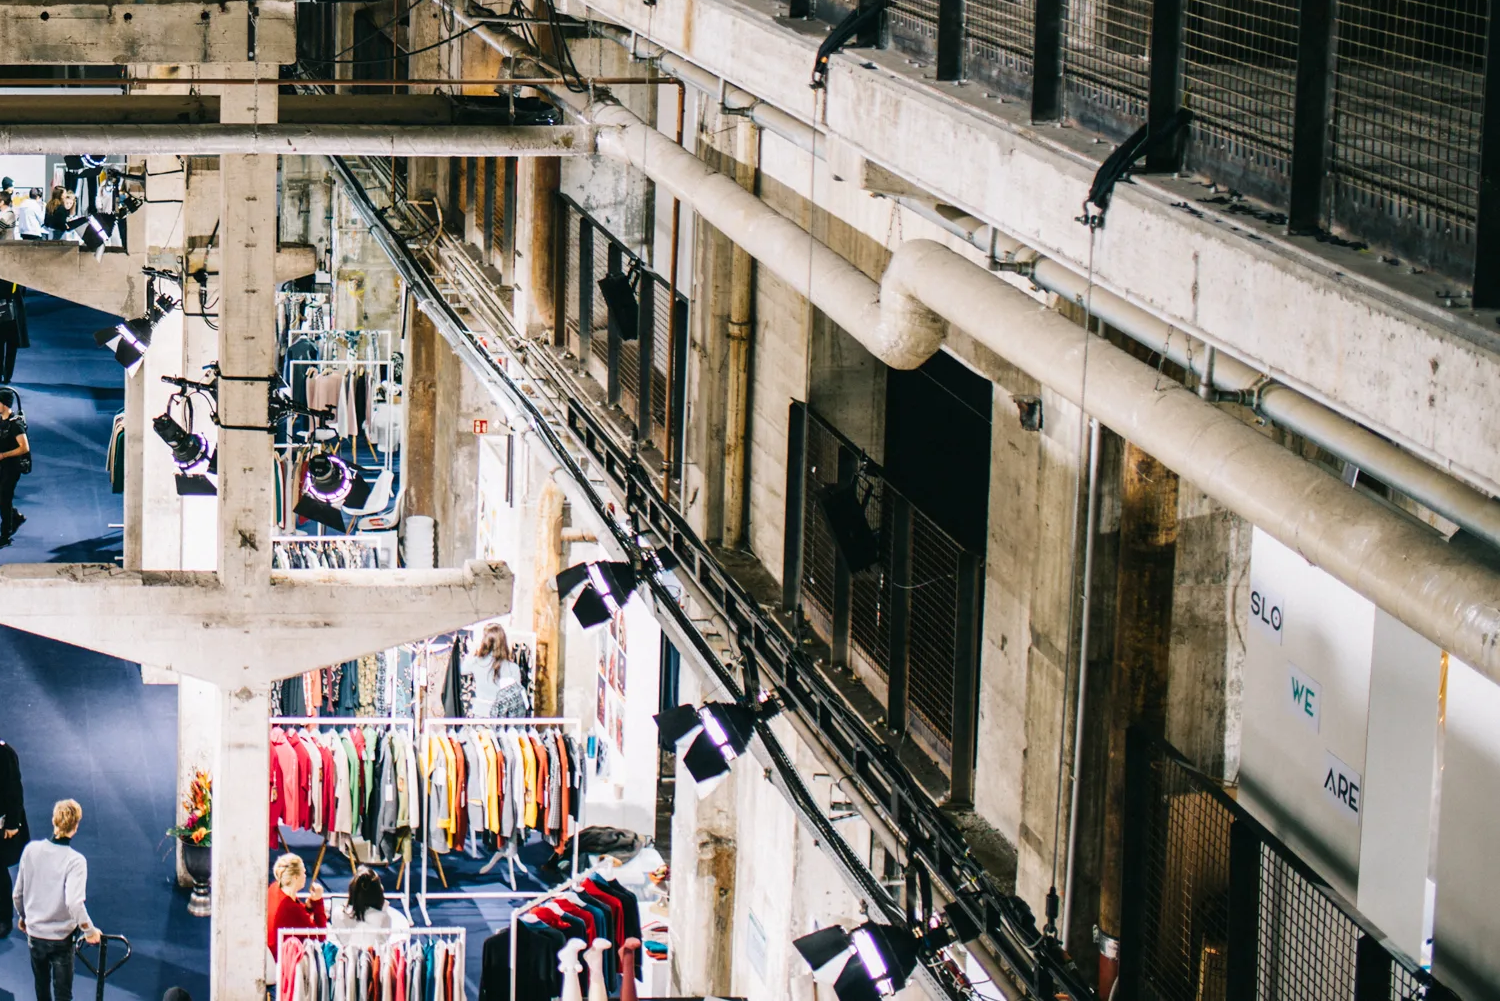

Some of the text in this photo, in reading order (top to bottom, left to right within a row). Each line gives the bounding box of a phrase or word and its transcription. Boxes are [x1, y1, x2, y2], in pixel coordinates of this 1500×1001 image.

[1250, 590, 1282, 631] SLO
[1291, 676, 1315, 717] WE
[1323, 767, 1360, 813] ARE
